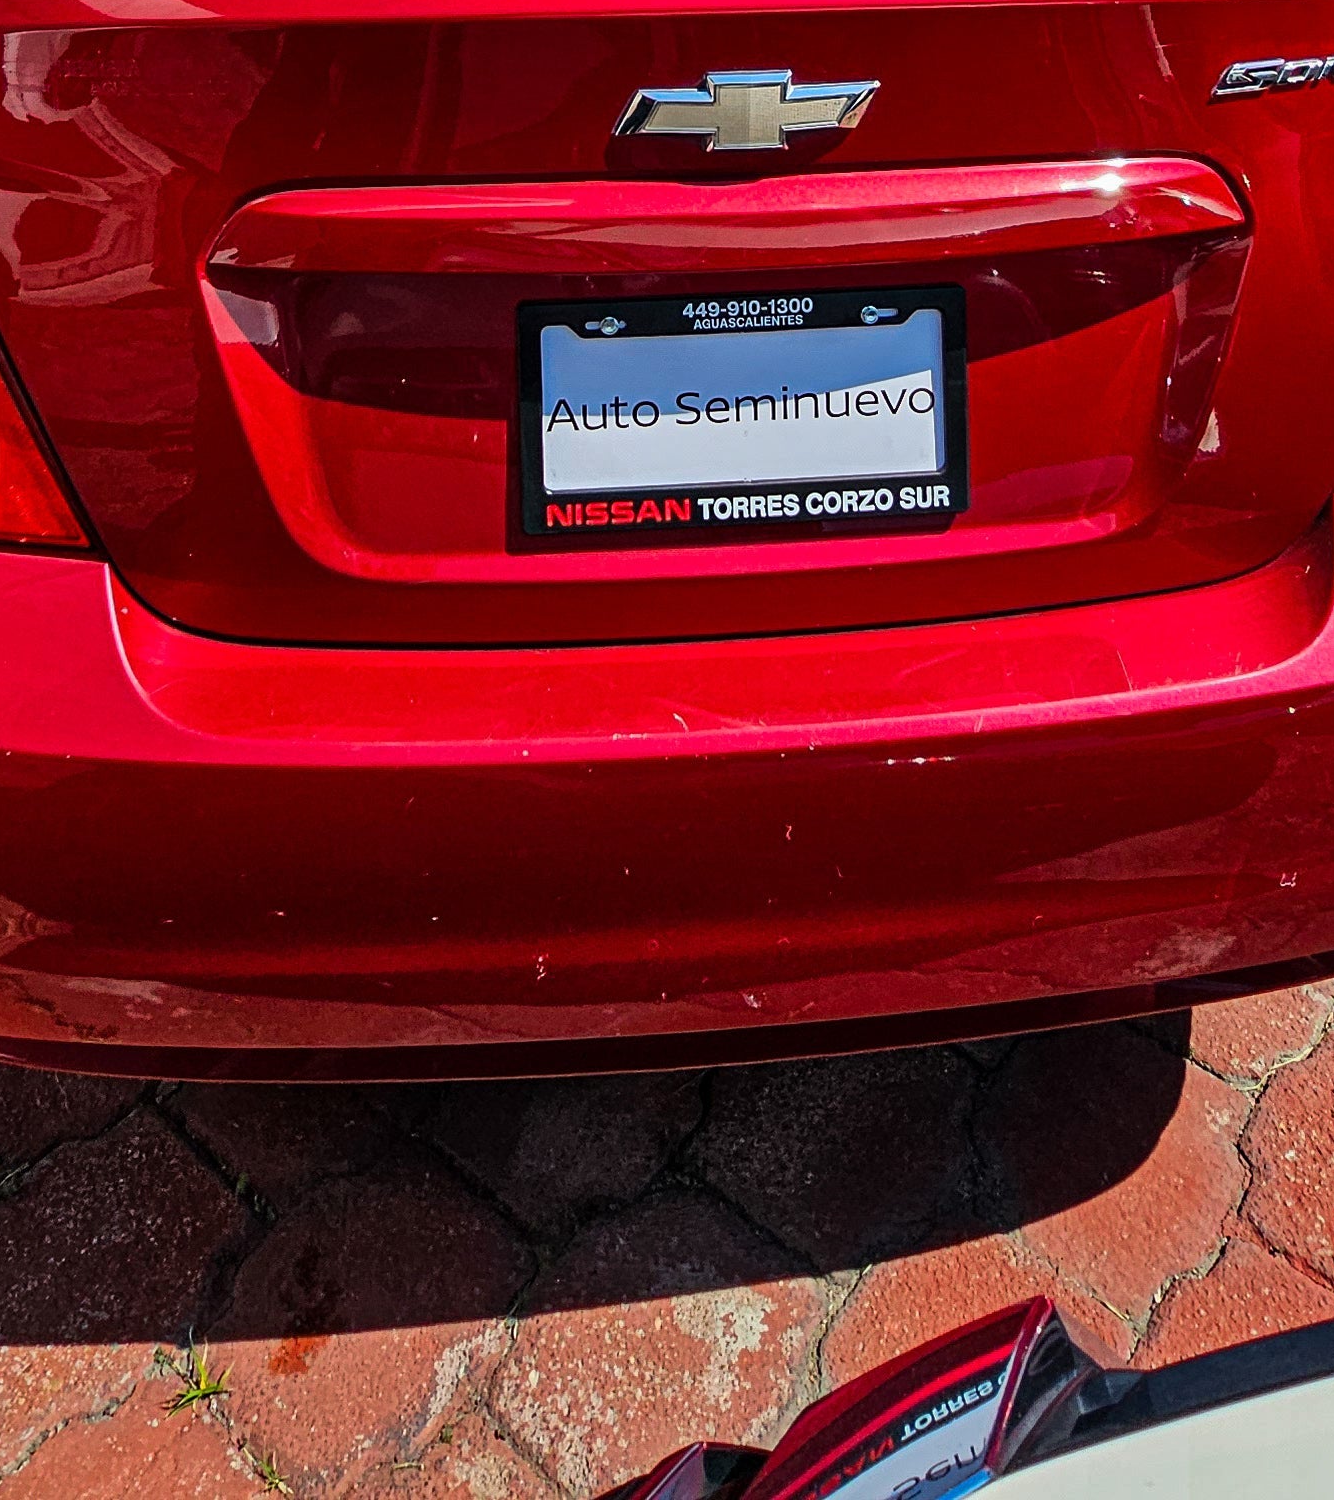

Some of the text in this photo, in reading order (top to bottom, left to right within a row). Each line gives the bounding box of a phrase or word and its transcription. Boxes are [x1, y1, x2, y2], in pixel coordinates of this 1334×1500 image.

[682, 297, 814, 319] 449-910-1300
[693, 314, 804, 331] AGUASCALIENTES
[546, 385, 936, 433] Auto Seminuevo
[546, 485, 951, 528] NISSAN TORRES CORZO SUR
